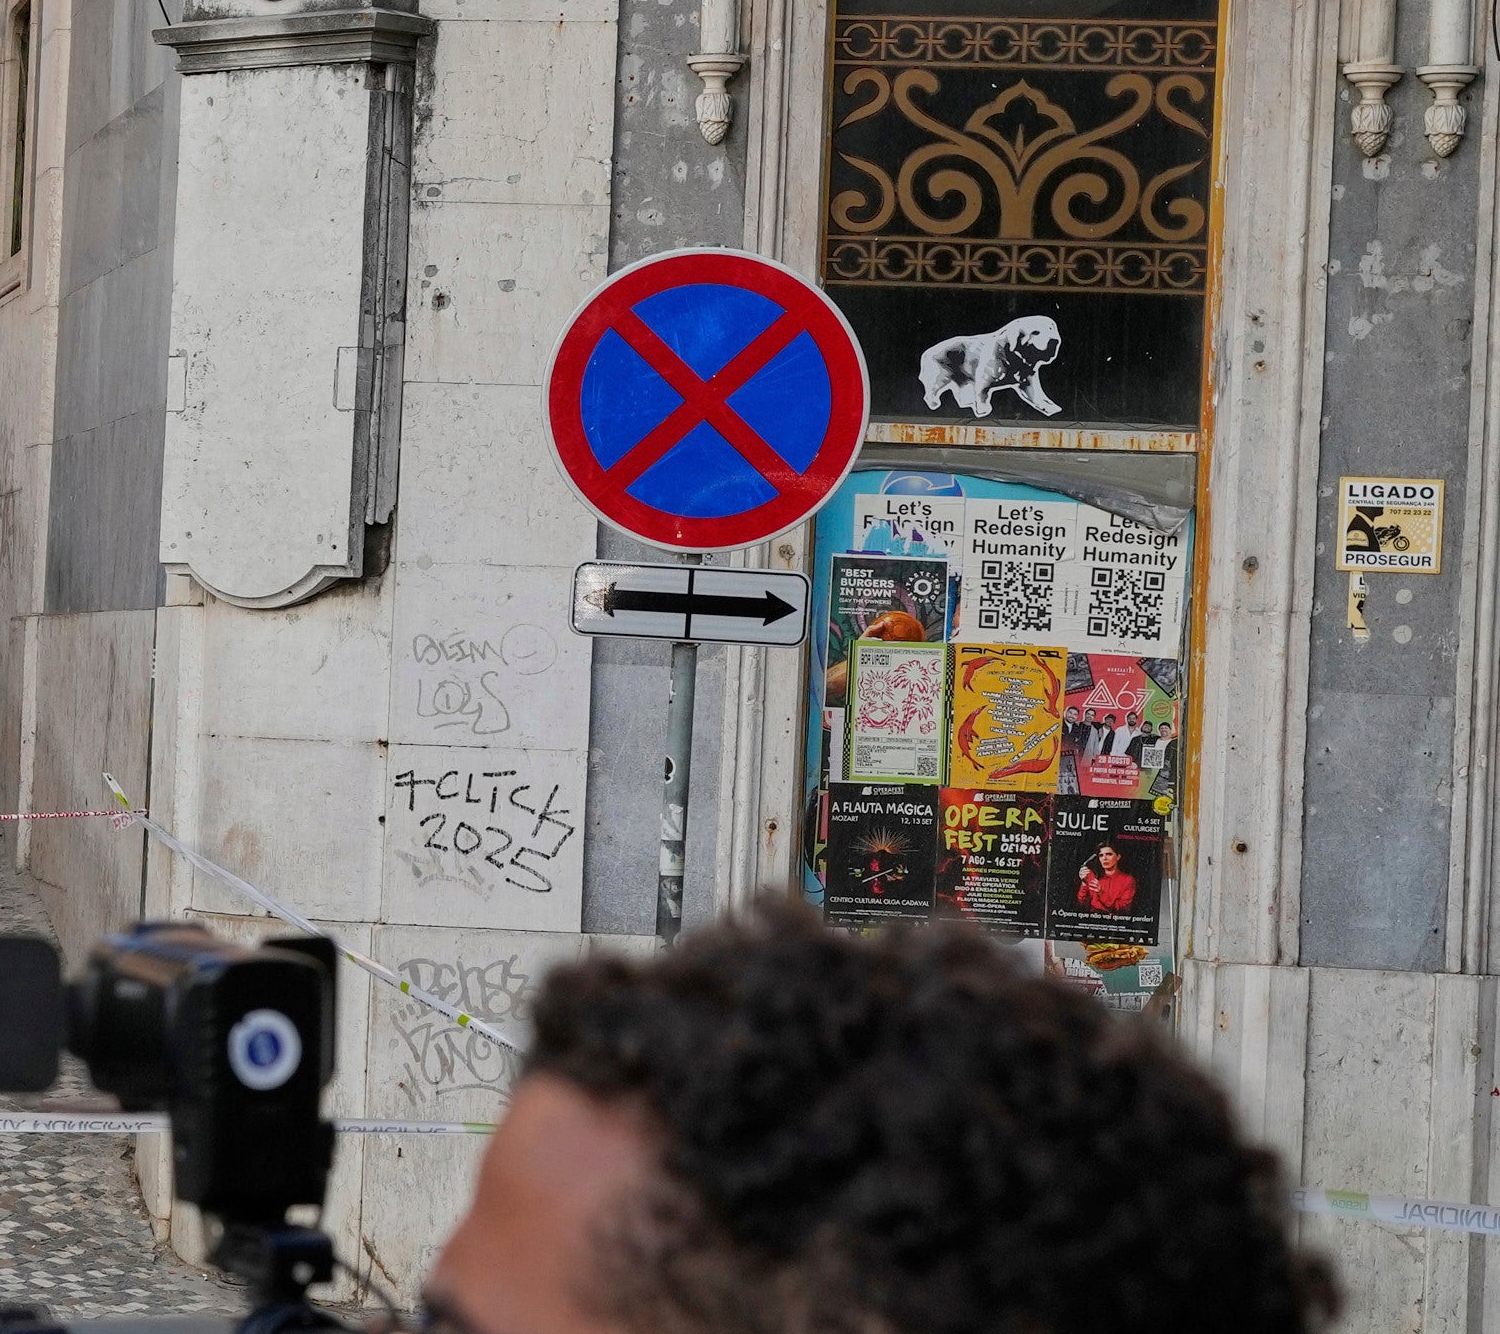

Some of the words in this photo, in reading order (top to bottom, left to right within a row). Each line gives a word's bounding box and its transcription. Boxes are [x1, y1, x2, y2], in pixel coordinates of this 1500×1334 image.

[1349, 485, 1434, 499] LIGADO
[974, 520, 1066, 540] Redesign
[1085, 526, 1178, 549] Redesign
[972, 539, 1066, 561] Humanity
[1083, 546, 1177, 570] Humanity
[1345, 553, 1431, 567] PROSEGUR
[840, 578, 895, 588] BURGERS
[839, 587, 855, 596] IN
[831, 802, 840, 812] A
[843, 802, 883, 814] FLAUTA
[886, 802, 933, 816] MÁGICA
[945, 803, 1043, 831] OPERA
[1056, 811, 1109, 831] JULIE
[1123, 825, 1160, 833] CULTURGEST
[943, 829, 998, 853] FEST
[1001, 833, 1042, 844] LISBOA
[420, 813, 552, 893] 2025
[1000, 843, 1041, 854] OEIRAS
[961, 855, 966, 864] 7
[968, 856, 985, 865] AGO
[994, 857, 1005, 867] 16
[1007, 857, 1023, 867] SET
